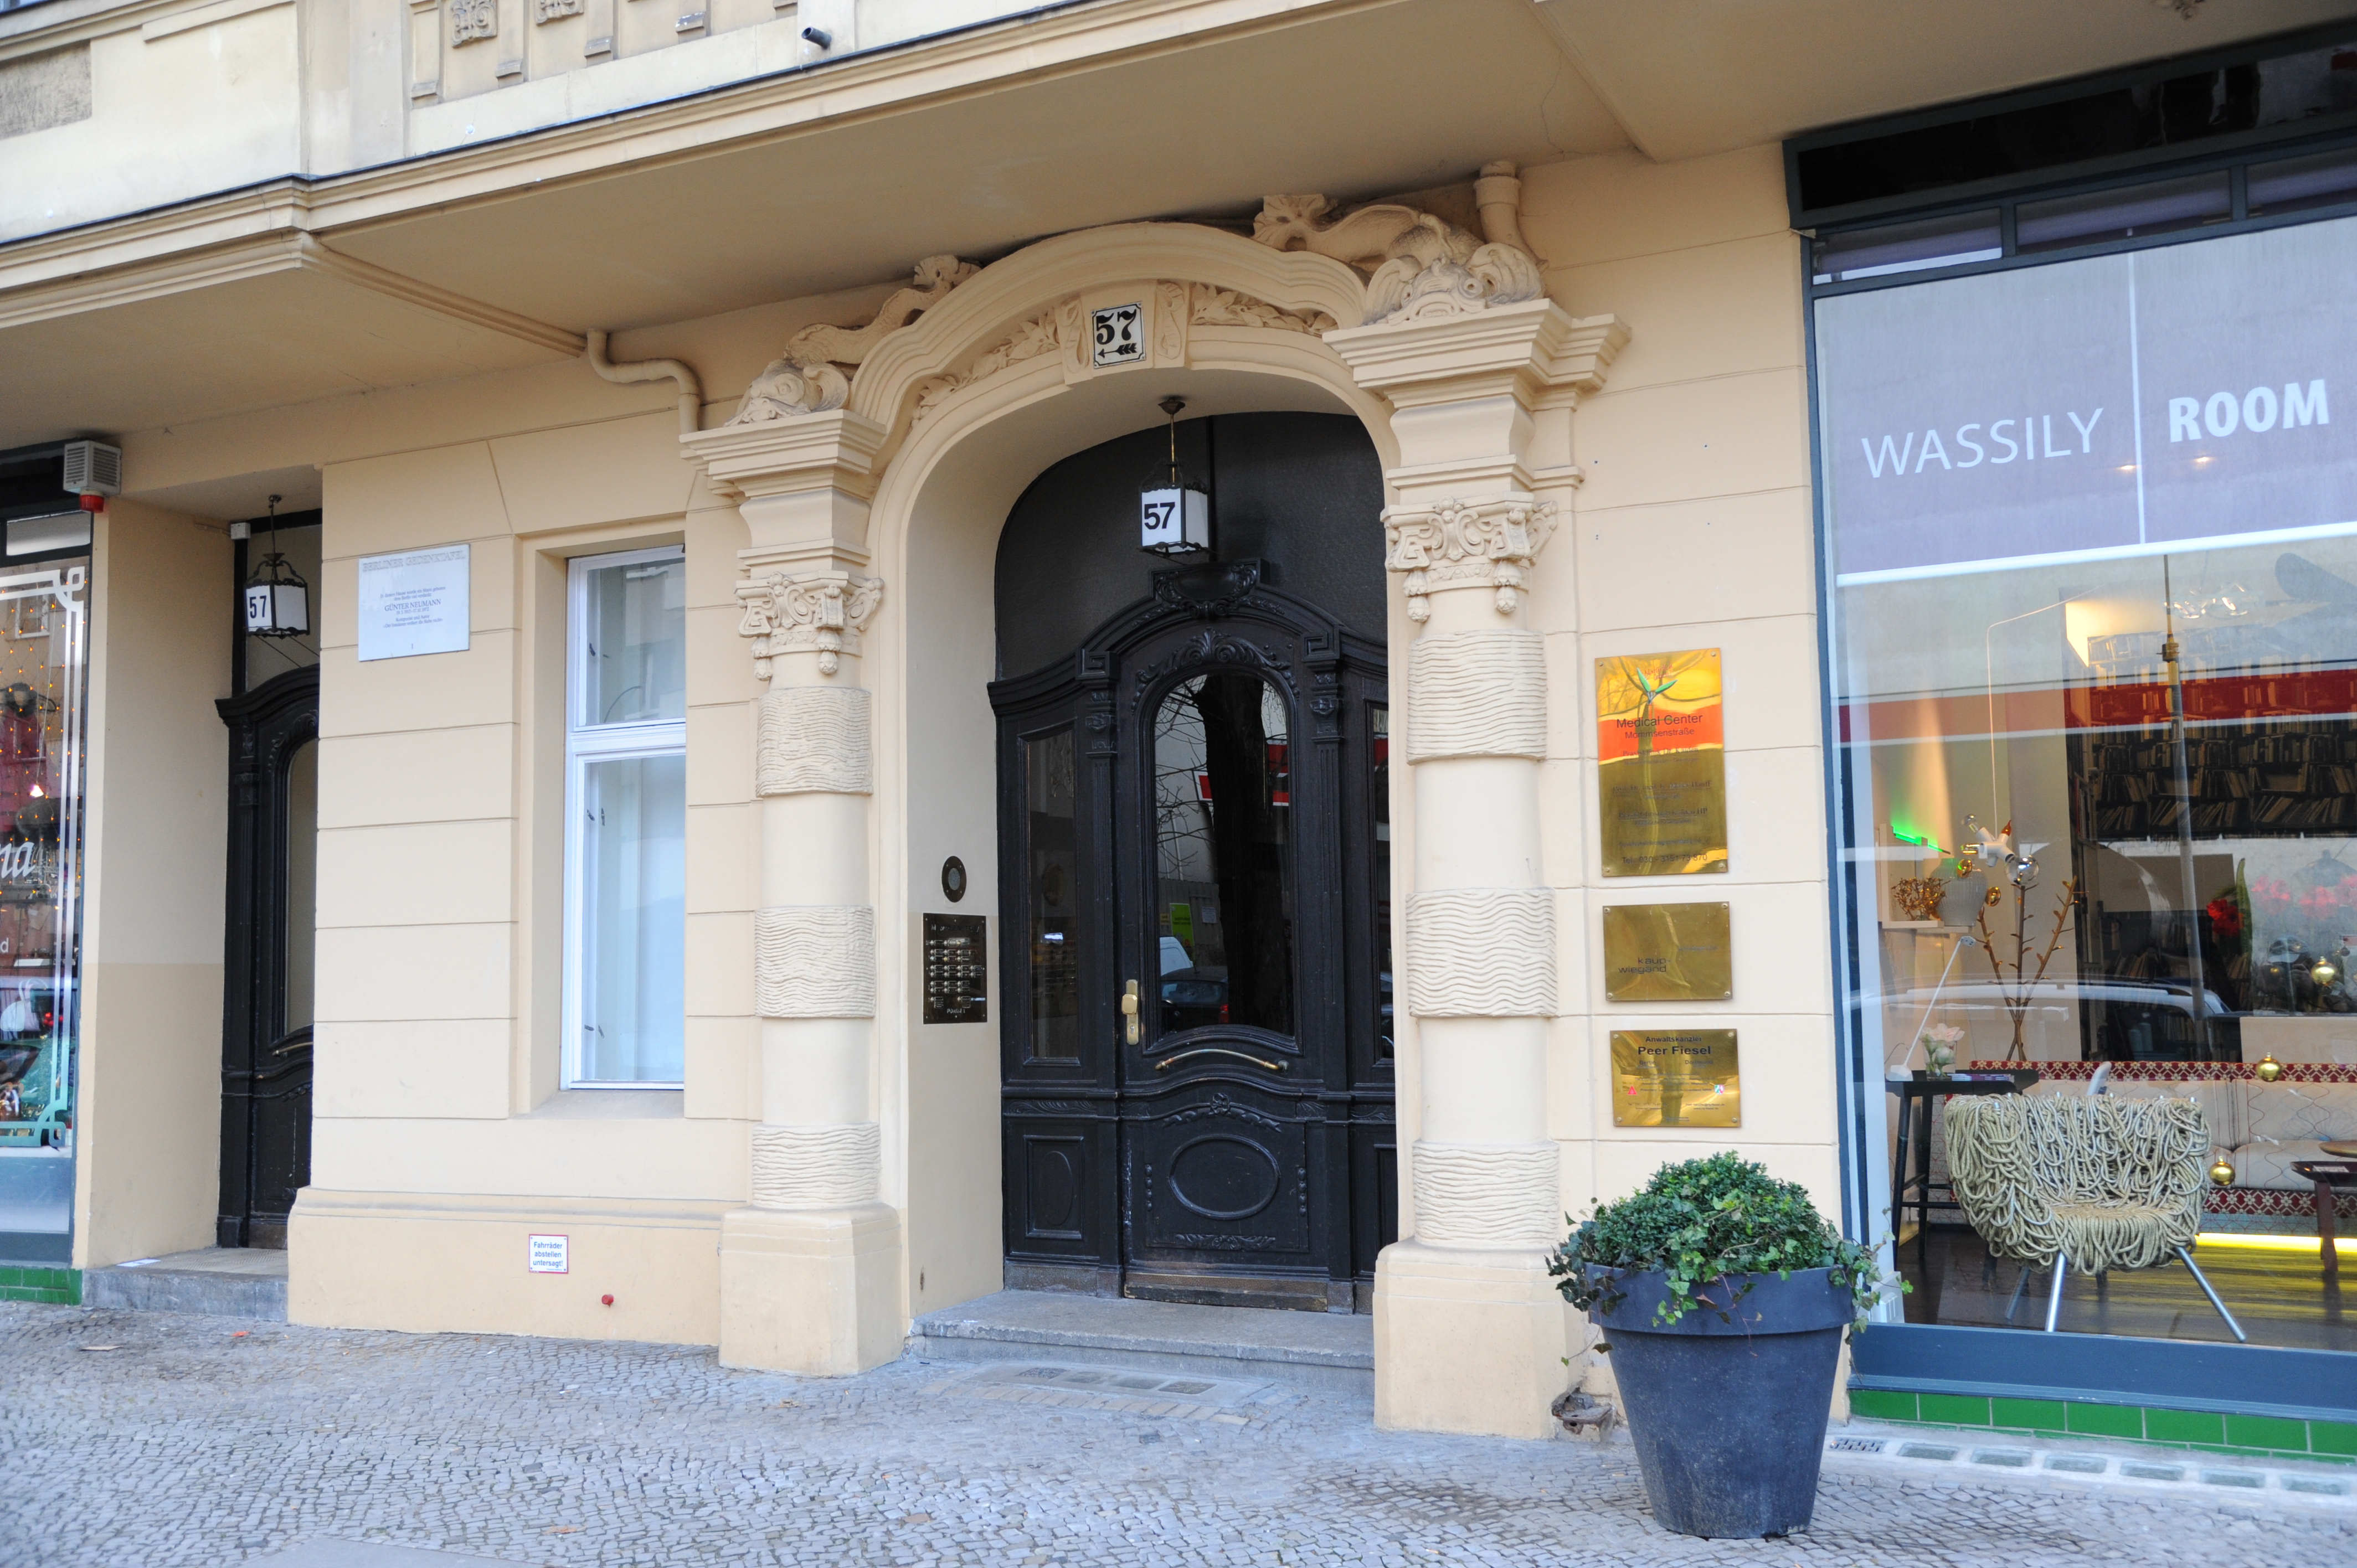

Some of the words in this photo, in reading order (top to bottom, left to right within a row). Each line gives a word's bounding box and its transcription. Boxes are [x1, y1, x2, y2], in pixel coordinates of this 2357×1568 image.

[1096, 308, 1137, 345] 57
[1861, 408, 2103, 478] WASSILY
[2169, 379, 2330, 443] ROOM
[1144, 502, 1175, 530] 57
[249, 595, 267, 618] 57
[384, 603, 409, 611] GÜNTER
[410, 599, 441, 608] NEUMANN
[1617, 716, 1660, 729] Medical
[1664, 714, 1703, 725] Center
[1625, 728, 1695, 739] Mommsenstraße
[1618, 965, 1666, 974] wiegand
[1638, 1046, 1668, 1055] Peer
[1672, 1046, 1711, 1055] Fiesel
[533, 1259, 563, 1268] untersagt!
